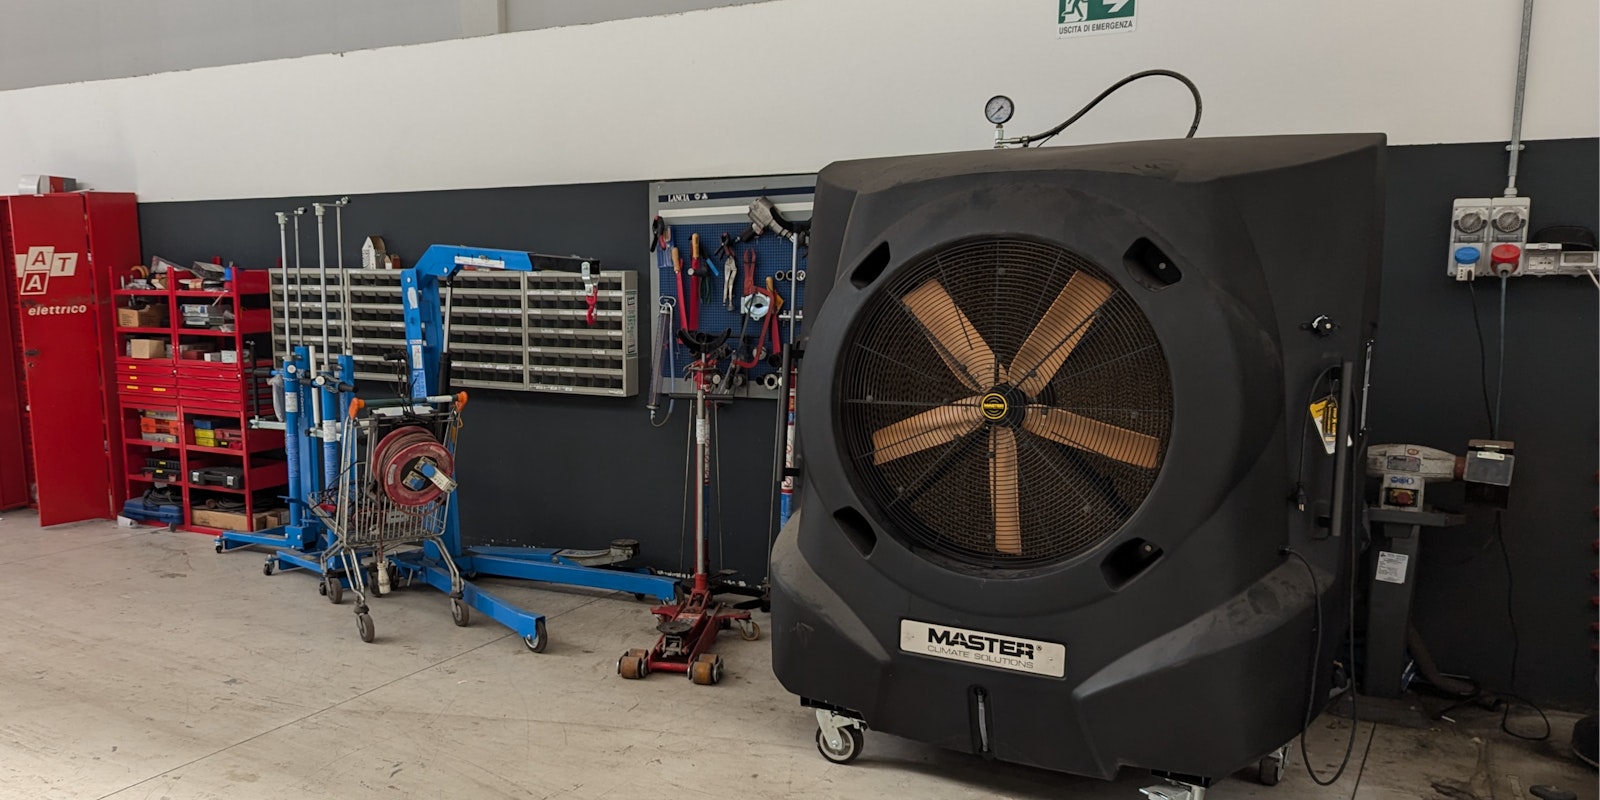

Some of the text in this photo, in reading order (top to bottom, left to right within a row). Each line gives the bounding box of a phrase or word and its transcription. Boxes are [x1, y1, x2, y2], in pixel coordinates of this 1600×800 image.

[1059, 20, 1133, 35] USCITA DI EMERGENZA
[667, 193, 690, 203] LANCIA
[27, 304, 88, 317] elettrico
[927, 644, 1034, 670] CLIMATE SOLUTIONS
